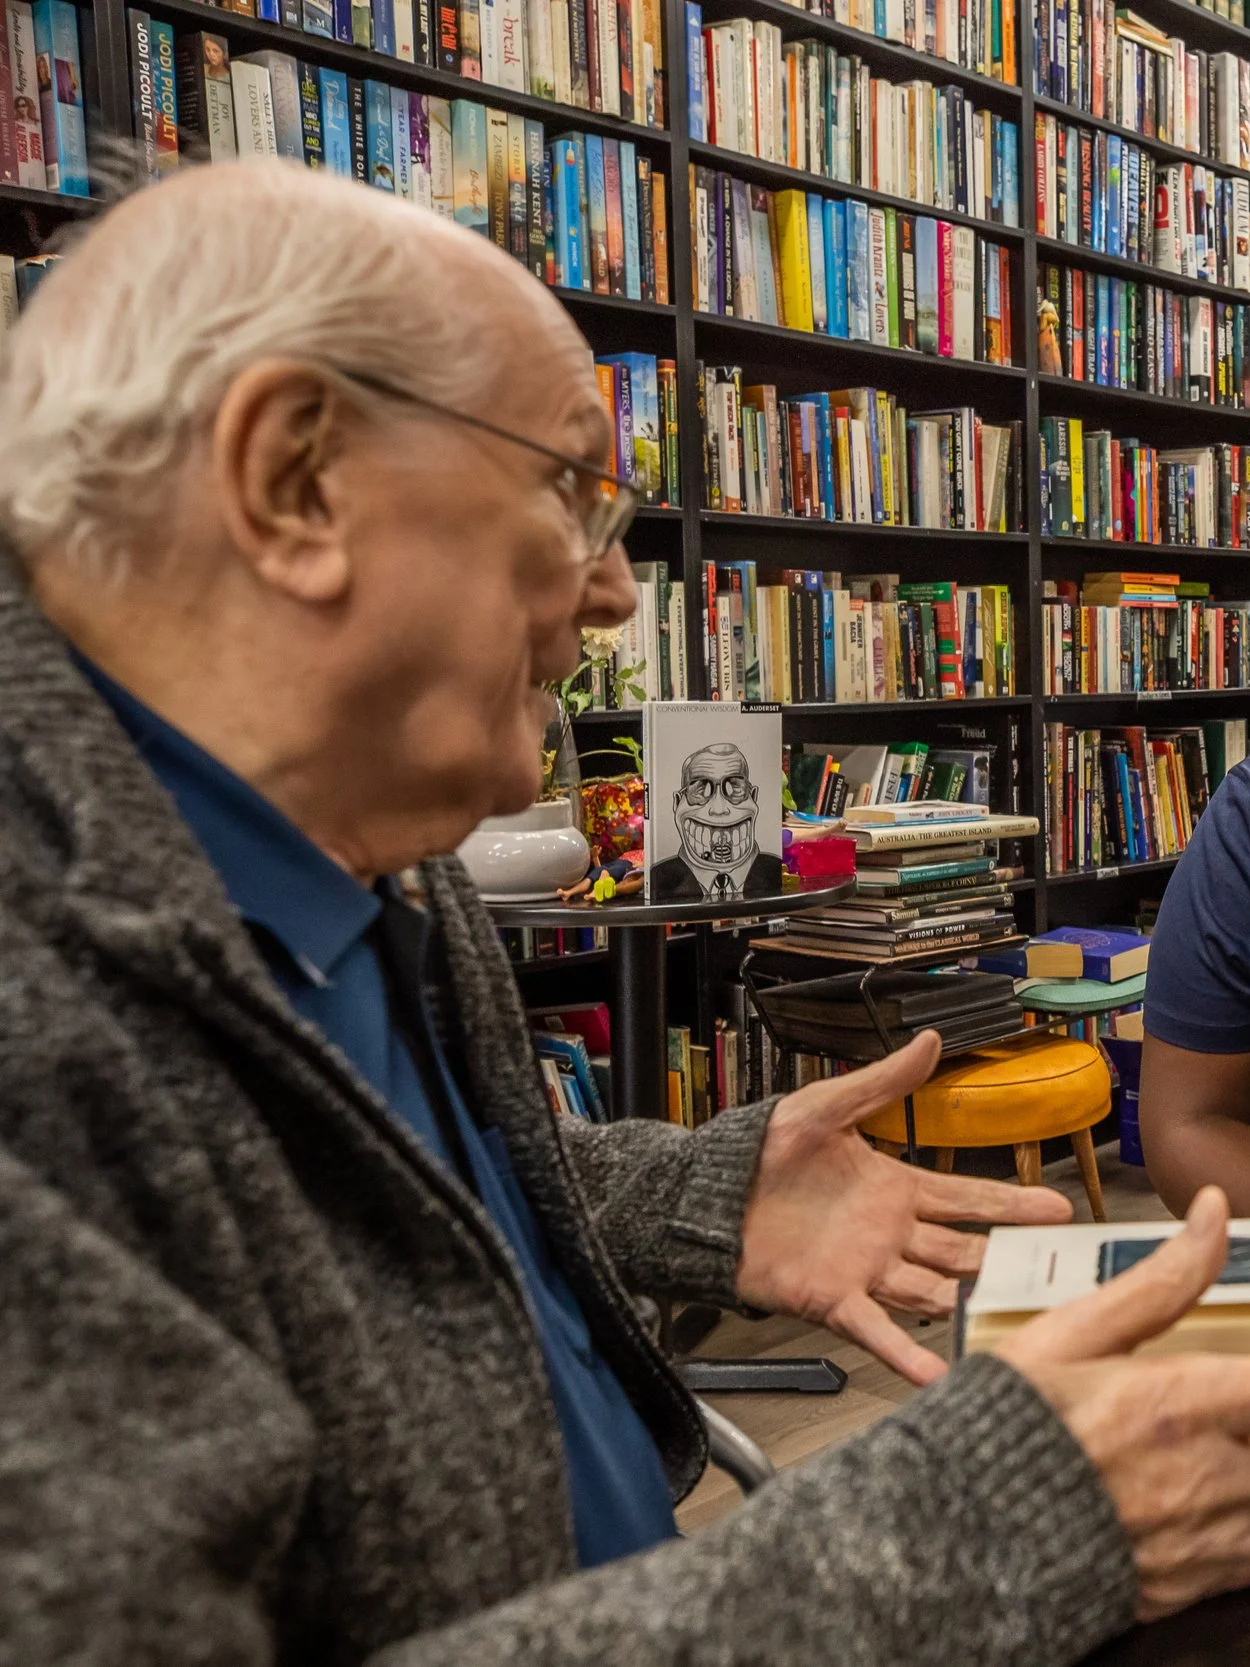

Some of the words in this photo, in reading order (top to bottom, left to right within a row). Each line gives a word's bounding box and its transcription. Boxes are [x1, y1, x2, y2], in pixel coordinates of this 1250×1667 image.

[136, 22, 150, 58] JODI
[157, 33, 172, 71] JODI
[503, 18, 520, 66] break
[139, 60, 153, 119] PICOULT
[354, 87, 362, 107] THE
[161, 76, 175, 143] PICOULT
[210, 83, 220, 134] DETTMAN
[219, 103, 229, 121] JOY
[248, 84, 259, 127] LOVERS
[397, 109, 405, 133] YEAR
[15, 123, 28, 163] ALDERSON
[29, 132, 41, 161] MAGGIE
[253, 129, 263, 155] AND
[355, 114, 363, 148] WHITE
[399, 146, 408, 184] FARMER
[493, 134, 503, 181] ZAMBEZI
[512, 135, 521, 176] STORM
[530, 131, 541, 188] HANNAH
[1037, 144, 1045, 168] LARRY
[1082, 140, 1091, 187] MISSING
[1038, 169, 1046, 203] COLLINS
[1128, 152, 1139, 224] DEAVER
[1172, 171, 1180, 190] LEN
[494, 191, 505, 218] TONY
[513, 184, 524, 222] GRACE
[531, 191, 542, 226] KENT
[1083, 189, 1092, 232] BEAUTY
[1235, 182, 1248, 233] LUDLUM
[871, 213, 884, 243] Judith
[873, 245, 886, 278] Krantz
[1049, 267, 1058, 298] GREG
[874, 303, 888, 333] Lovers
[1147, 319, 1155, 346] KILO
[1087, 326, 1096, 351] NIGHT
[1226, 320, 1234, 354] Patterson
[1088, 353, 1096, 373] TRAP
[1147, 347, 1156, 378] CLASS
[1058, 421, 1067, 456] LARSSON
[659, 583, 667, 617] Betrayal
[856, 614, 864, 649] JENNIFER
[709, 634, 717, 661] SAMMY
[735, 652, 743, 670] DEAD
[710, 661, 718, 688] HAGAR
[722, 664, 730, 691] URIS
[656, 705, 708, 713] CONVENTIONAL
[710, 705, 739, 713] WISDOM
[961, 727, 986, 739] Freud
[884, 772, 898, 800] FISH
[877, 833, 916, 845] AUSTRALIA:
[918, 832, 932, 841] THE
[933, 829, 967, 841] GREATEST
[968, 826, 992, 837] ISLAND
[890, 907, 920, 921] Samurai
[908, 928, 934, 939] VISIONS
[935, 927, 943, 935] OF
[944, 924, 966, 933] POWER
[934, 935, 961, 946] CLASSICAL
[961, 932, 980, 942] WORLD
